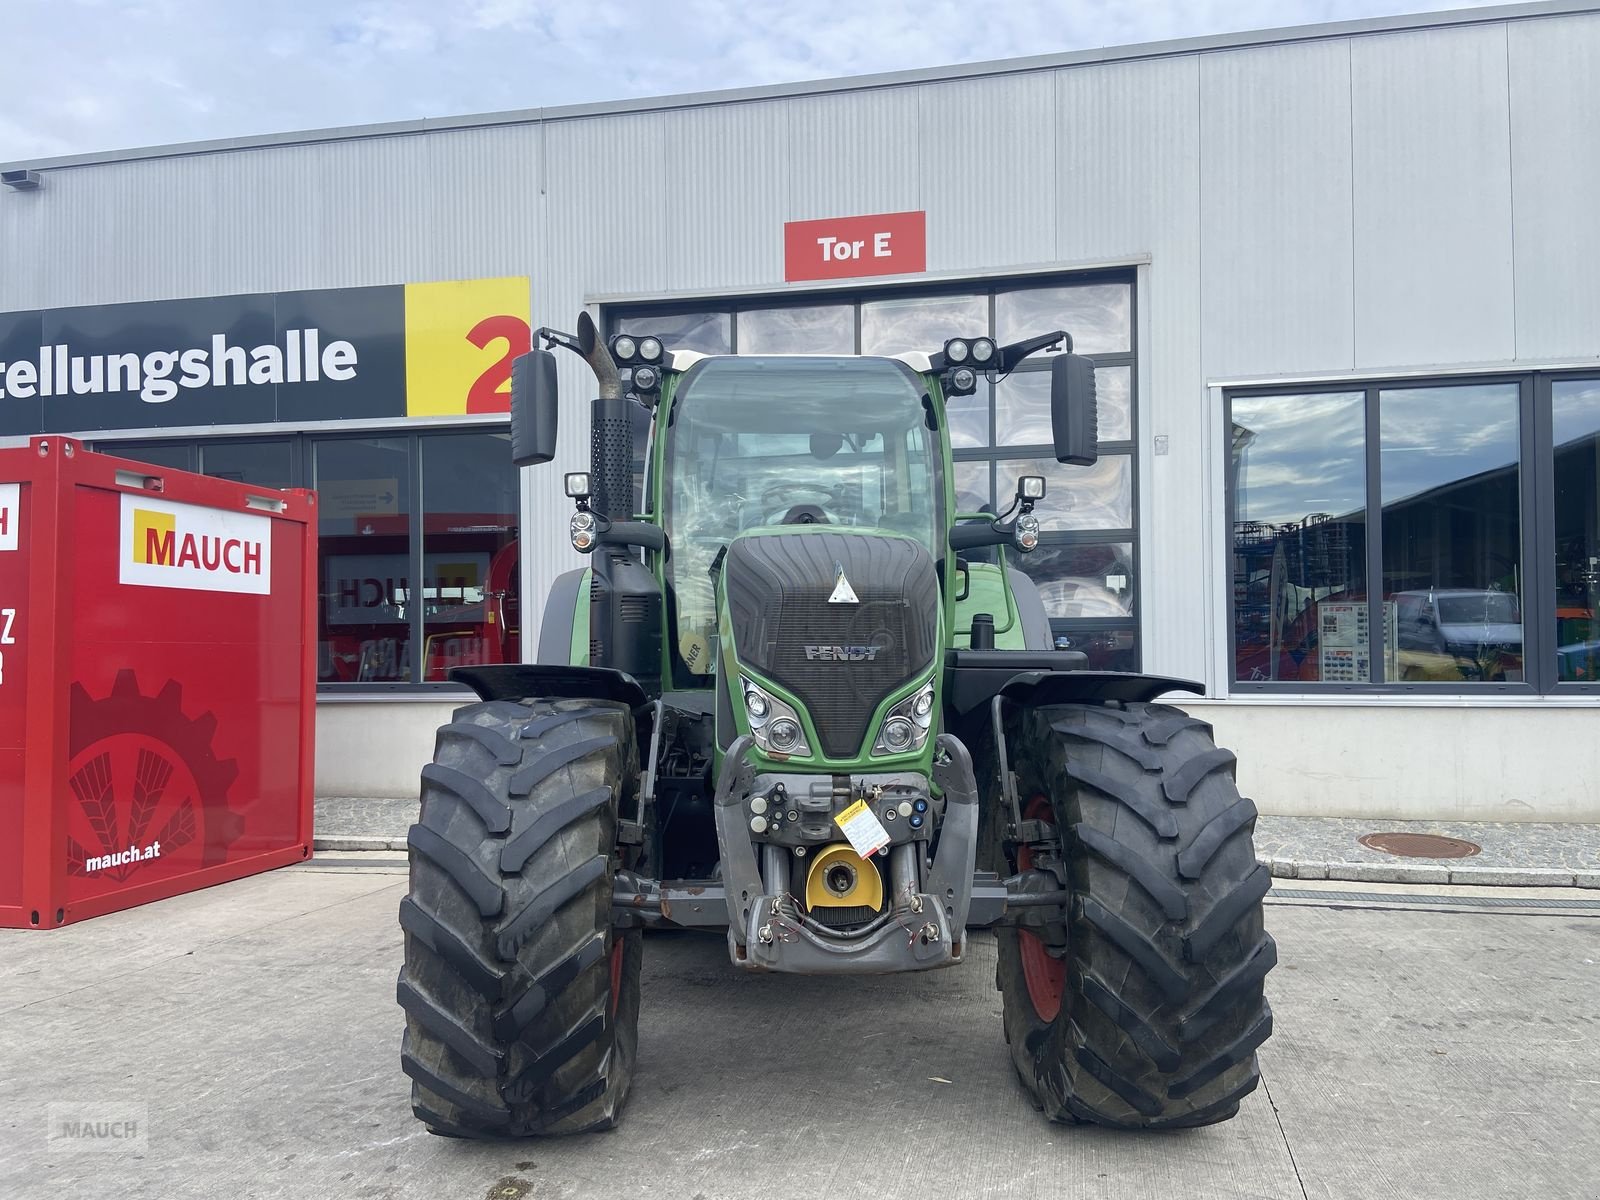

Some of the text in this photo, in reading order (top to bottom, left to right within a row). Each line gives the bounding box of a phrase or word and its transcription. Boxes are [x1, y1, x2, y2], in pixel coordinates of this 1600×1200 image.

[817, 232, 892, 261] Tor E
[465, 315, 530, 415] 2
[146, 527, 262, 576] MAUCH
[804, 645, 881, 661] FENDT
[85, 840, 161, 873] mauch.at
